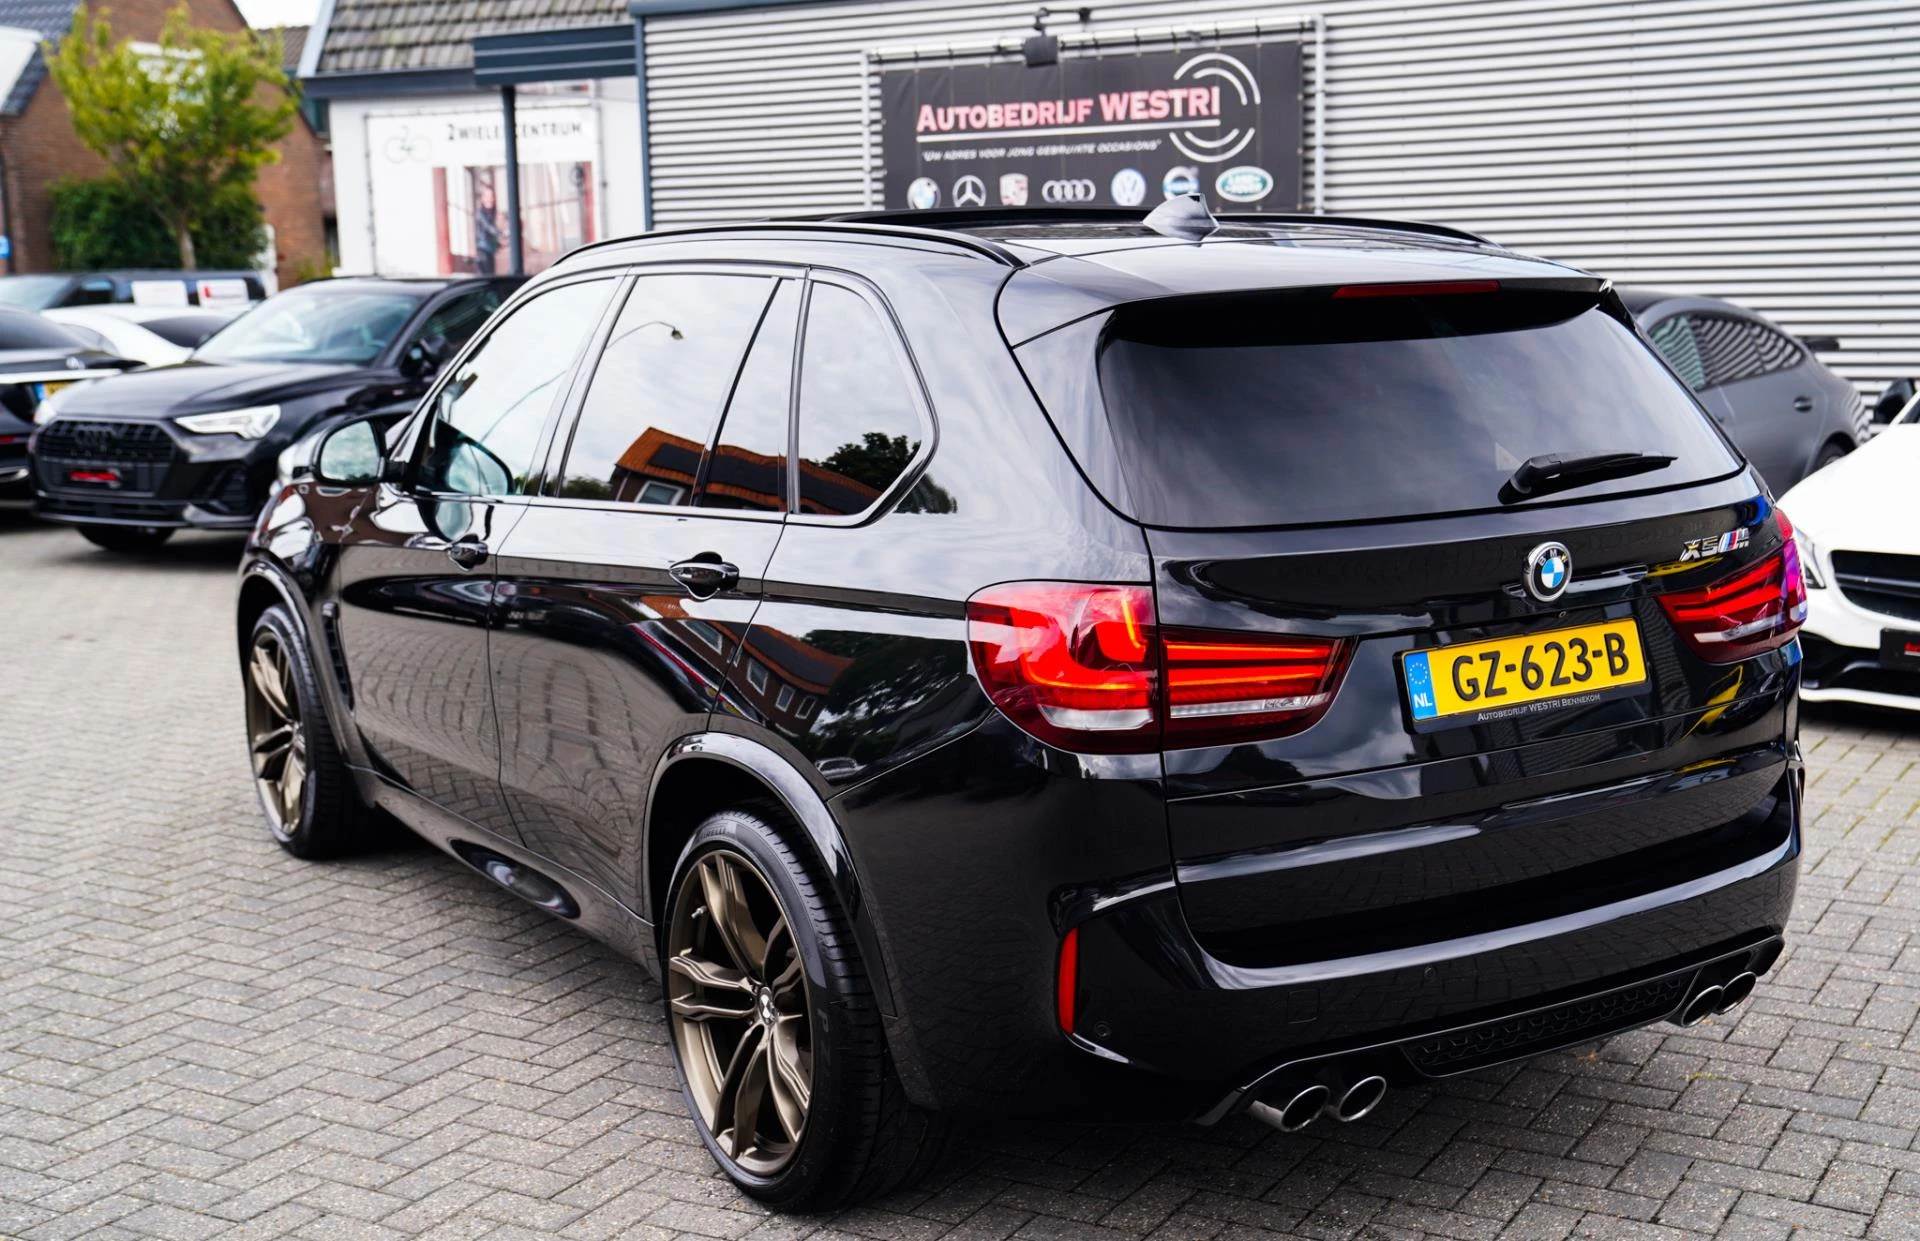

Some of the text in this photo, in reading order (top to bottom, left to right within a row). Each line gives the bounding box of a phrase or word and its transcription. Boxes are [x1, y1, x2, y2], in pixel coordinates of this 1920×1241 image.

[916, 86, 1221, 132] AUTOBEDRIJF WESTRI
[1451, 632, 1629, 702] GZ-623-B
[1414, 692, 1433, 708] NL
[1477, 693, 1601, 721] AUTOBEDRIJF WESTRI BENNEKOM
